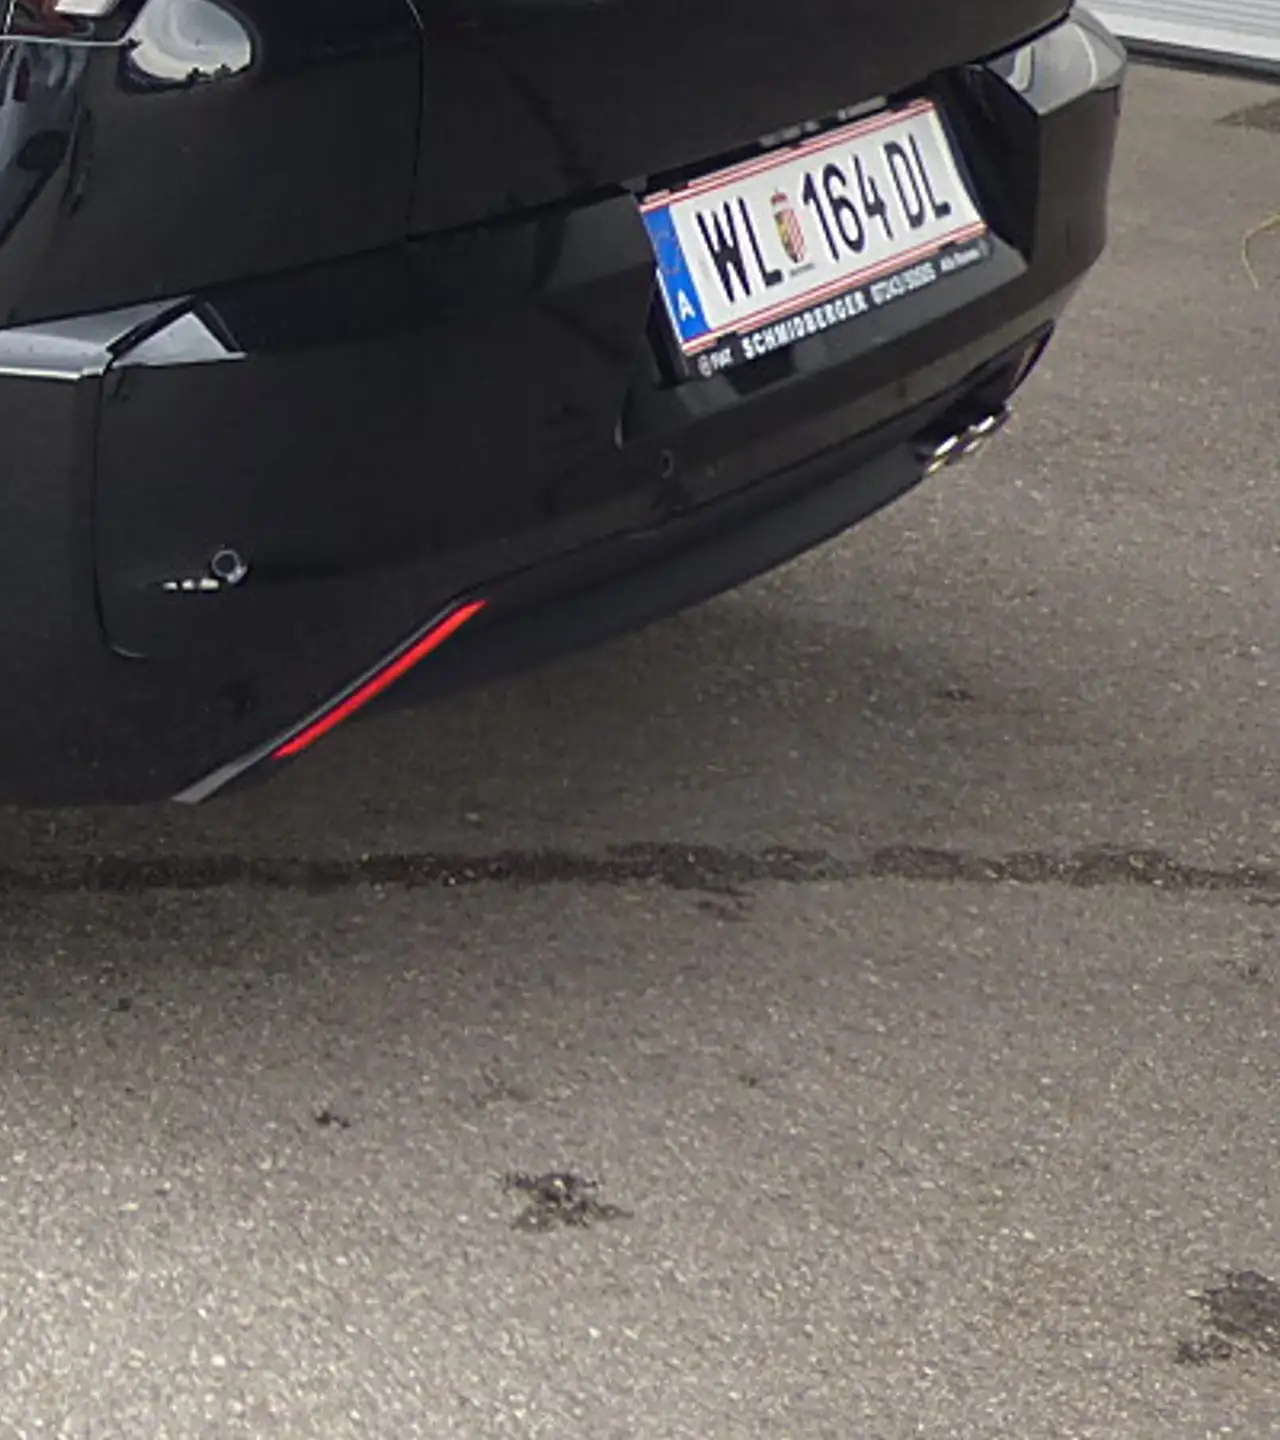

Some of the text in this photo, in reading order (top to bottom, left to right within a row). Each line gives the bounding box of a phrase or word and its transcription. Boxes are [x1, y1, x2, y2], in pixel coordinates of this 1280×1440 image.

[695, 132, 952, 305] WL 164 DL
[676, 288, 696, 322] A
[742, 290, 869, 360] SCHMIDBERGER
